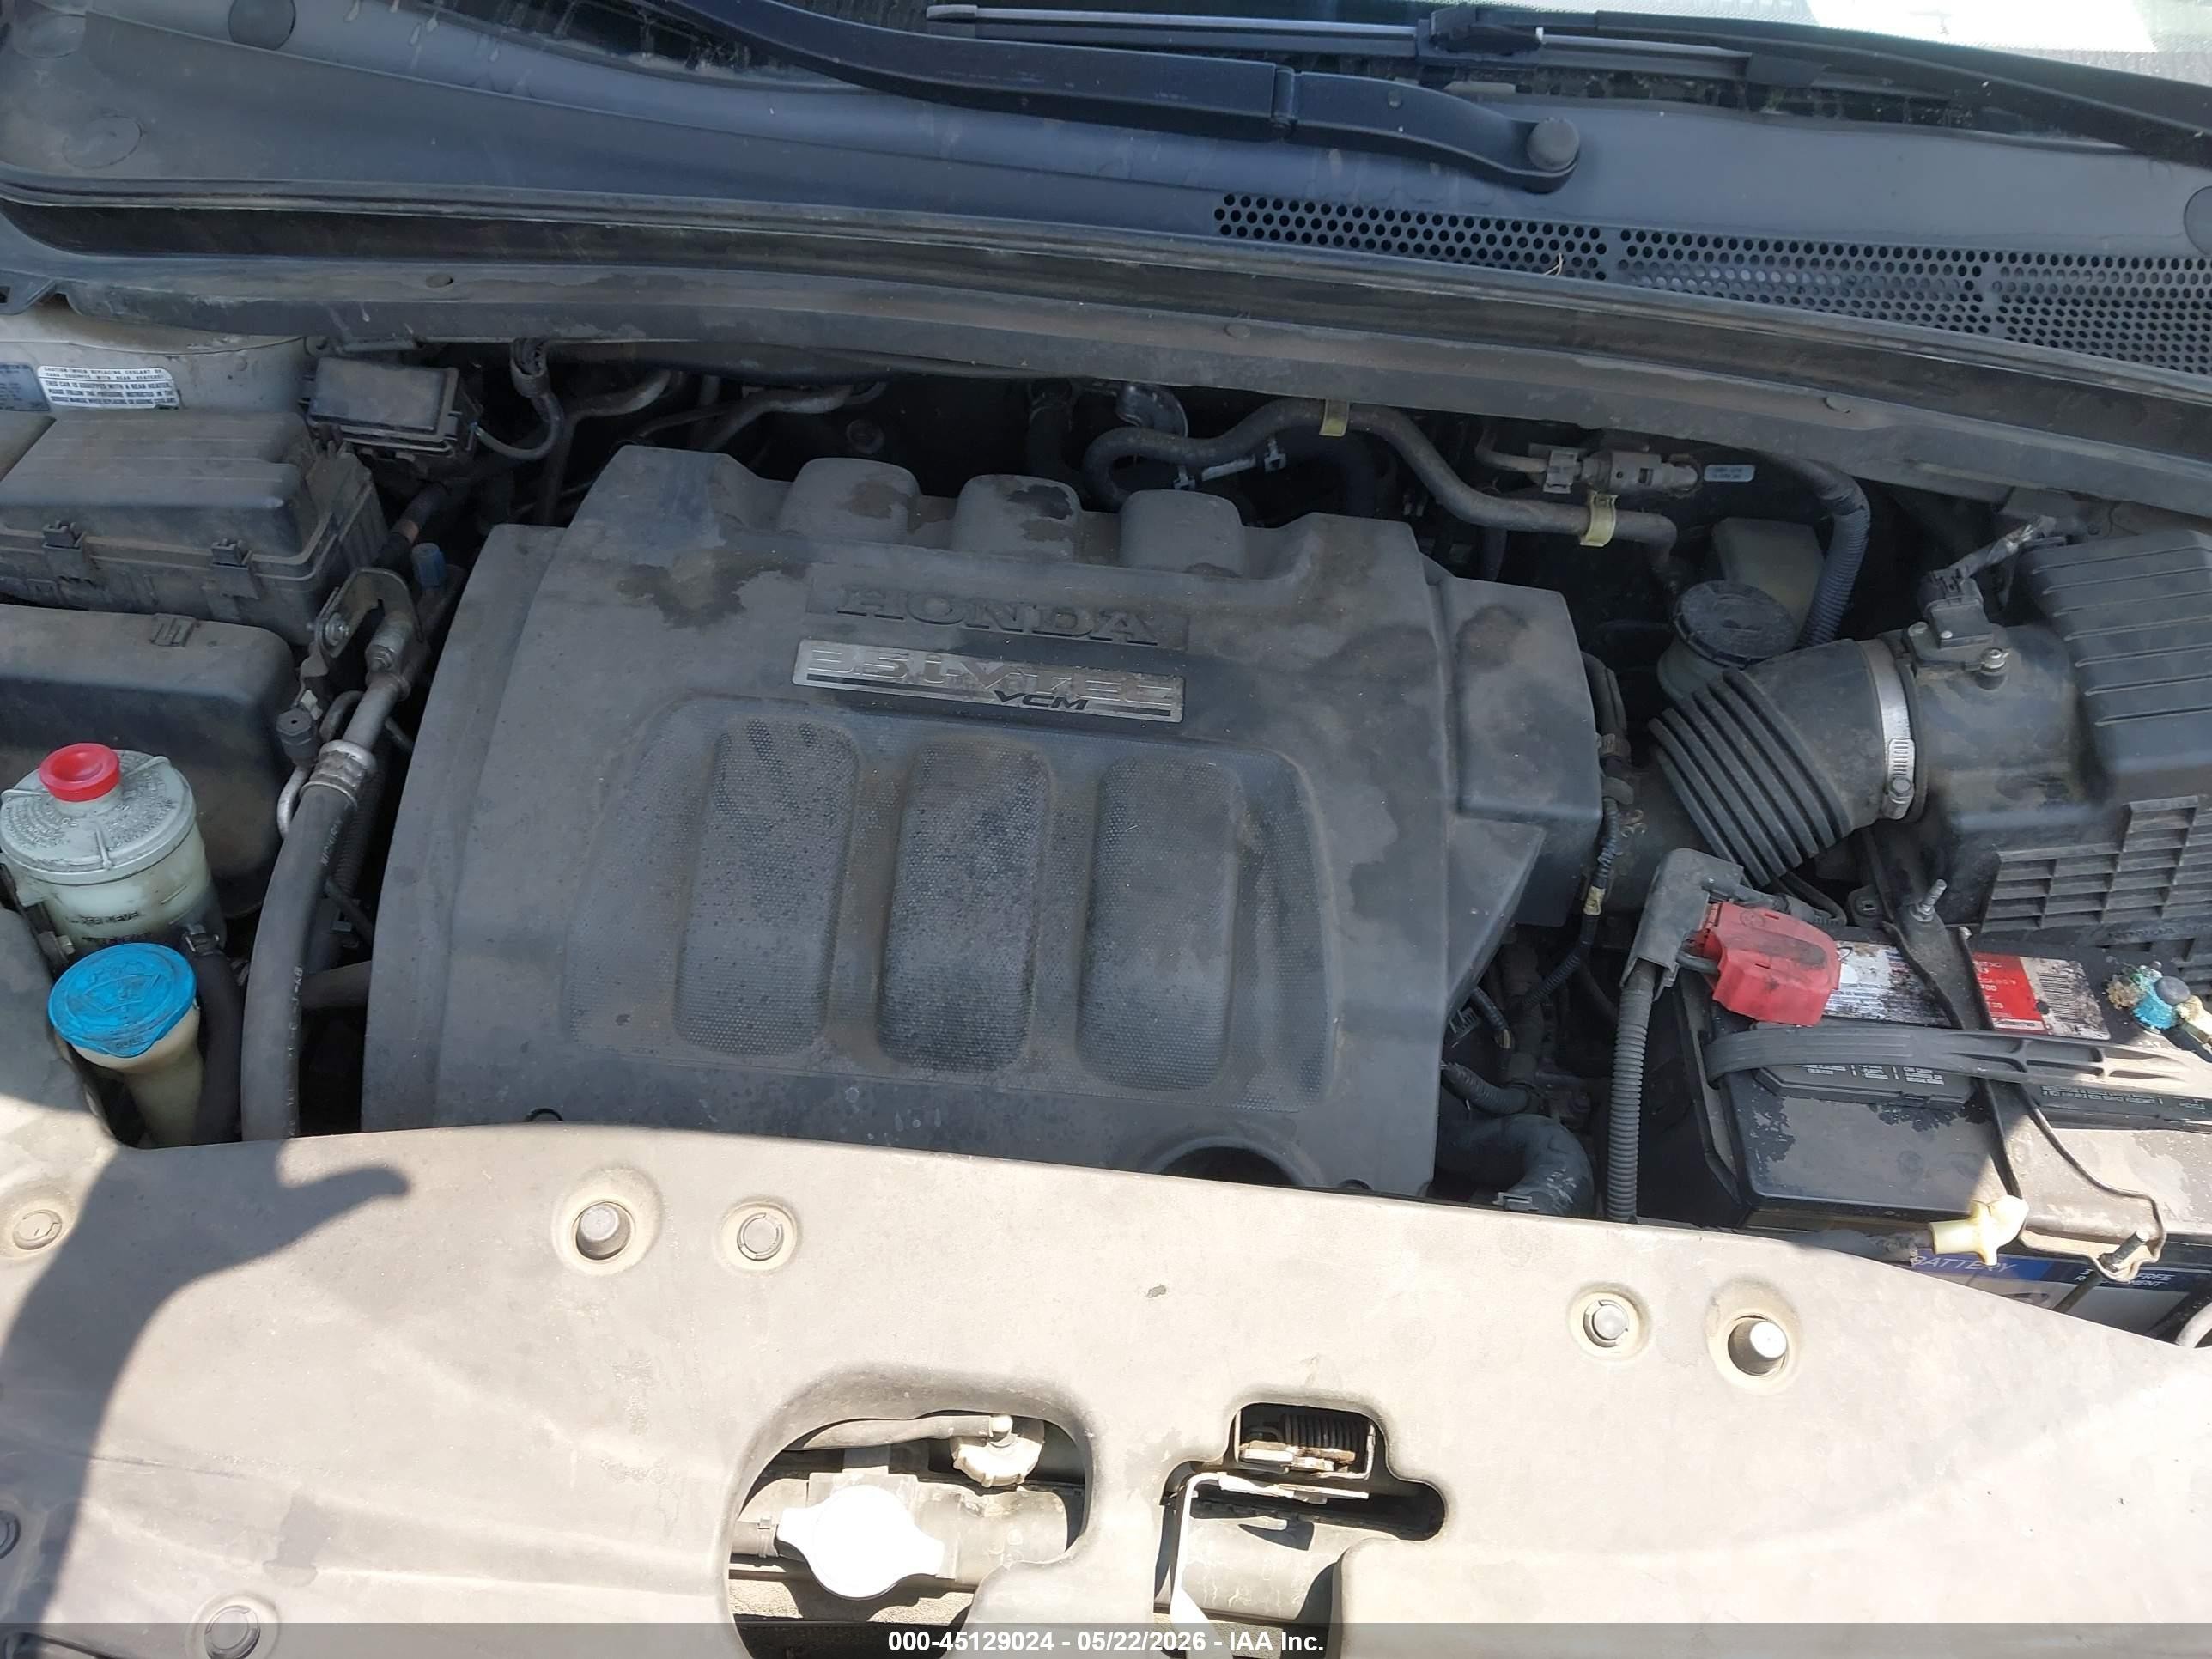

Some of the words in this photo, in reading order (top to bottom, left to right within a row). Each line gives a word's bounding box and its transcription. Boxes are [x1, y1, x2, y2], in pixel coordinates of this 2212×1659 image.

[837, 586, 1158, 645] HONDA
[993, 689, 1091, 712] VCM
[1911, 1255, 2017, 1273] BATTERY
